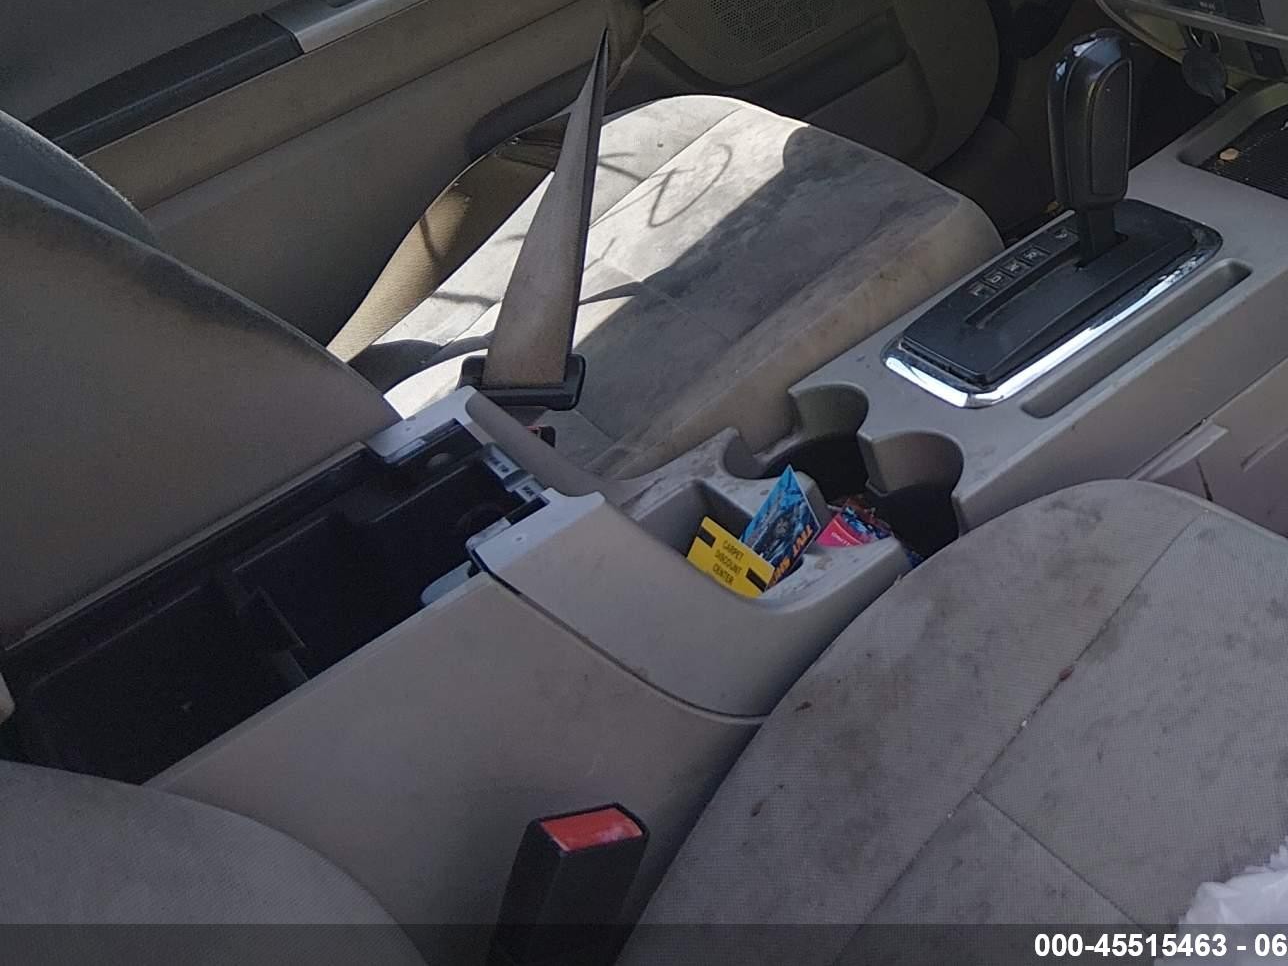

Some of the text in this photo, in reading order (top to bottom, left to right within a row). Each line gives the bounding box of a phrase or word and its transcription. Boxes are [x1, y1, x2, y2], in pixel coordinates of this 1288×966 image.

[722, 539, 745, 561] CARPET
[714, 549, 743, 575] DISCOUNT
[712, 563, 735, 585] CENTER
